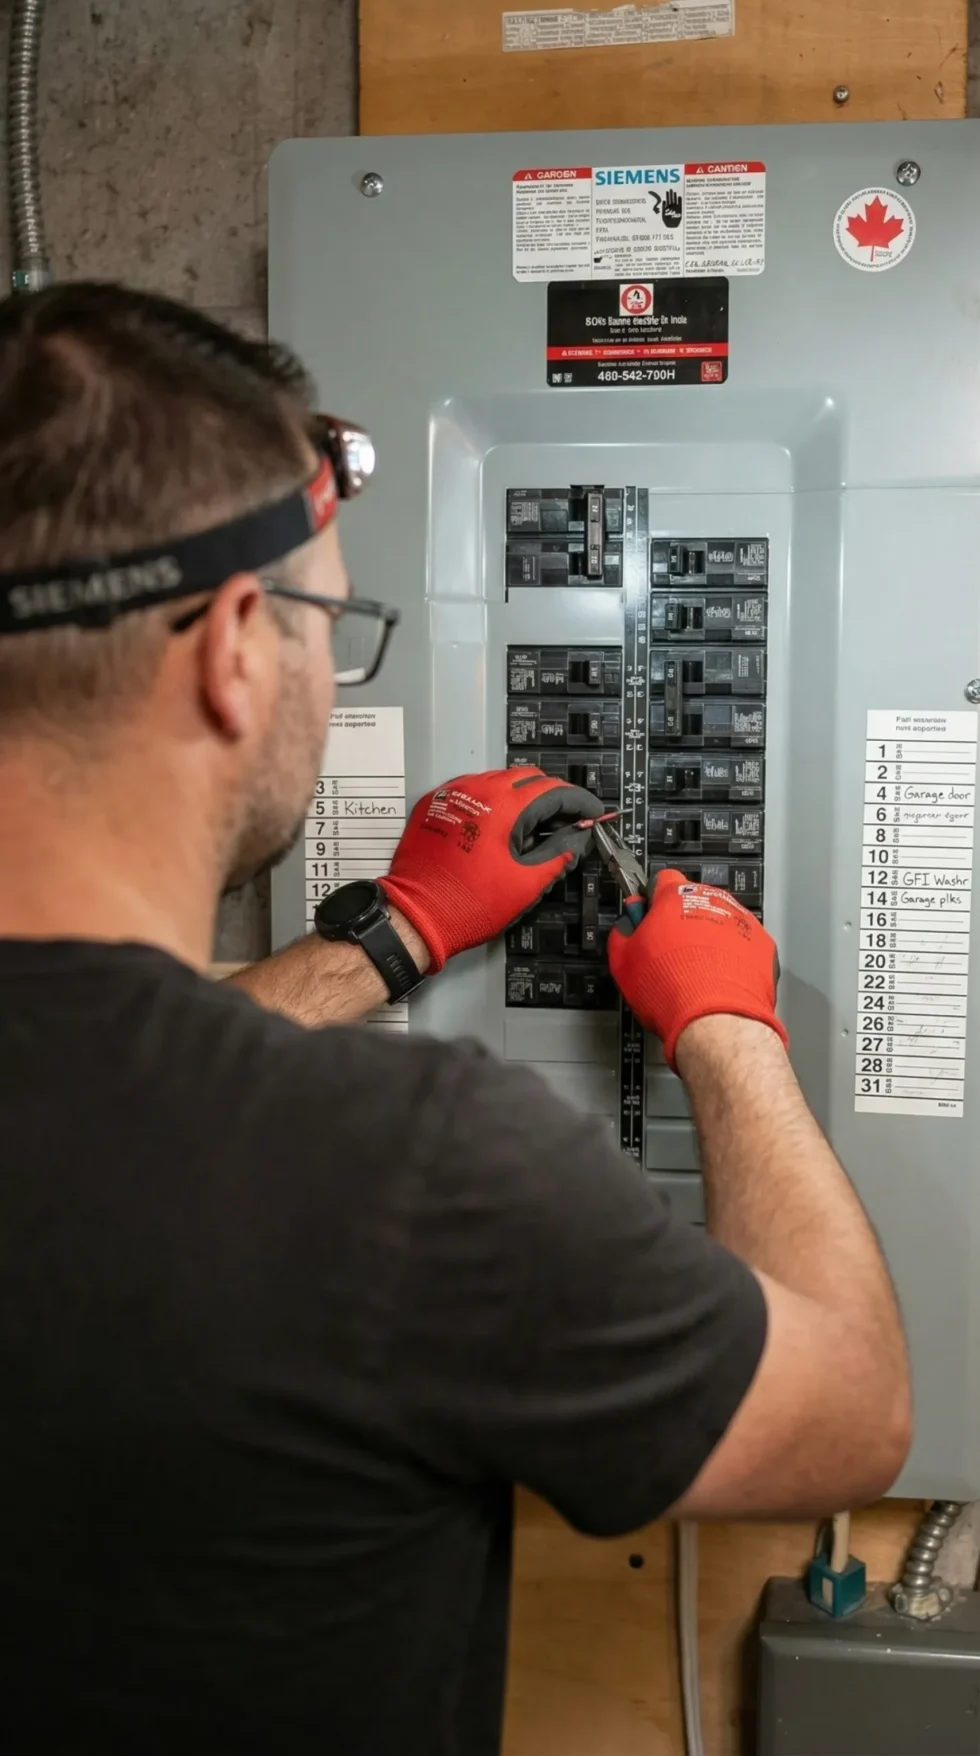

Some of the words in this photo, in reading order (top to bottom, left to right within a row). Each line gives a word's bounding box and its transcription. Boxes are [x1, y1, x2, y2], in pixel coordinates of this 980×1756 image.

[595, 168, 681, 186] SIEMENS
[9, 555, 182, 619] SIEMENS
[878, 744, 886, 758] 1
[877, 765, 888, 779] 2
[315, 781, 325, 795] 3
[876, 786, 887, 800] 4
[904, 785, 945, 804] Garage
[948, 786, 972, 800] door
[315, 801, 325, 815] 5
[344, 801, 397, 815] Kitchen
[876, 807, 887, 821] 6
[315, 822, 325, 835] 7
[875, 828, 886, 842] 8
[315, 842, 326, 856] 9
[868, 849, 889, 864] 10
[312, 862, 328, 877] 11
[867, 870, 888, 885] 12
[903, 871, 930, 886] GFI
[933, 874, 969, 886] Washr
[312, 883, 331, 897] 12
[867, 891, 888, 905] 14
[900, 891, 936, 908] Garage
[866, 912, 887, 927] 16
[866, 933, 887, 948] 18
[864, 954, 886, 968] 20
[863, 975, 886, 989] 22
[863, 996, 885, 1010] 24
[862, 1016, 885, 1031] 26
[861, 1037, 884, 1051] 27
[861, 1058, 883, 1073] 28
[860, 1078, 880, 1093] 31
